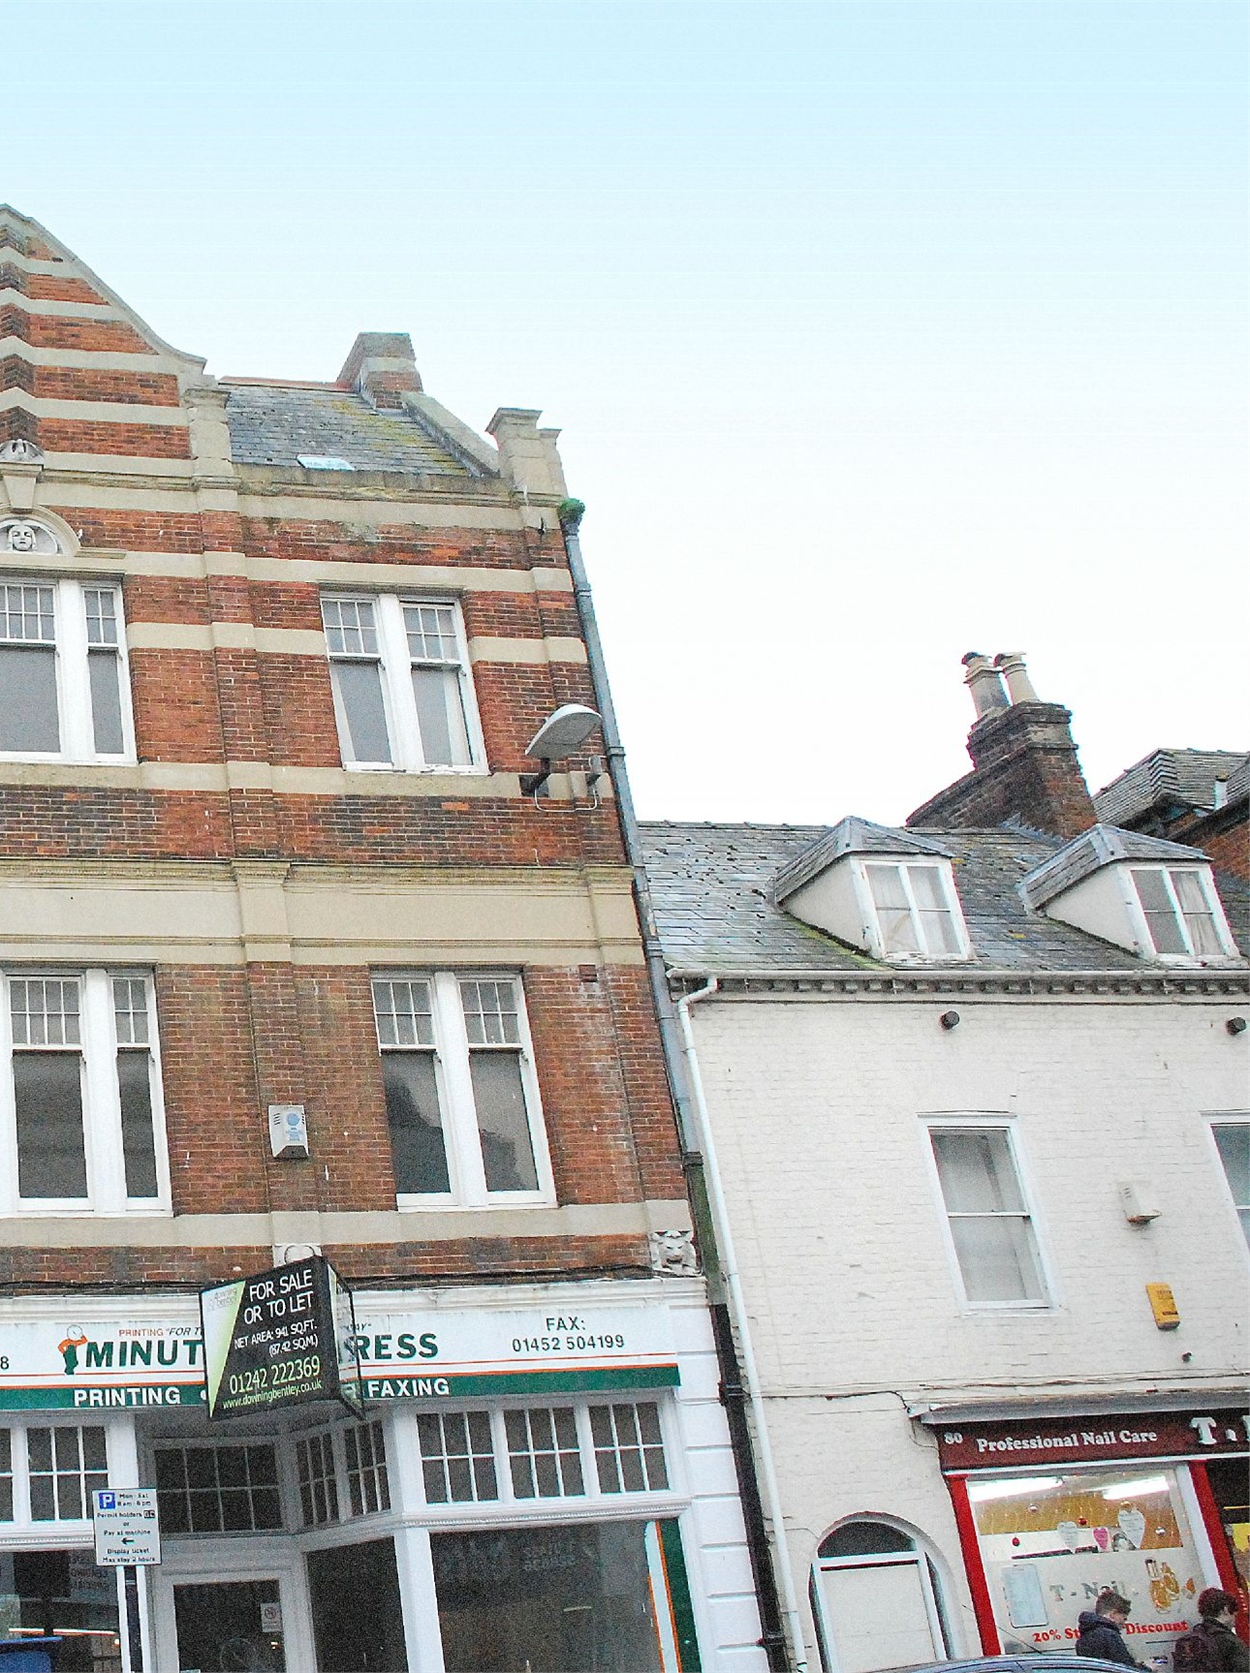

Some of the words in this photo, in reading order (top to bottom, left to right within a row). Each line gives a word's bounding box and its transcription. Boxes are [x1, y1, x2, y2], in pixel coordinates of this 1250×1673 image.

[249, 1281, 276, 1302] FOR
[279, 1269, 313, 1294] SALE
[243, 1305, 263, 1325] OR
[266, 1298, 286, 1318] TO
[289, 1291, 314, 1313] LET
[118, 1327, 164, 1337] PRINTING
[545, 1316, 586, 1331] FAX:
[234, 1335, 250, 1350] NET
[251, 1329, 274, 1346] AREA:
[275, 1326, 289, 1339] 941
[355, 1332, 439, 1360] RESS
[512, 1336, 561, 1352] 01452
[566, 1334, 625, 1350] 504199
[86, 1339, 205, 1368] MINUT
[229, 1368, 268, 1395] 01242
[270, 1355, 320, 1385] 222369
[73, 1387, 181, 1407] PRINTING
[222, 1380, 323, 1409] www.downingbentley.co.uk
[366, 1378, 450, 1397] FAXING
[944, 1431, 964, 1445] 80
[976, 1433, 1079, 1453] Professional
[1080, 1430, 1117, 1446] Nail
[1118, 1429, 1158, 1443] Care
[1032, 1629, 1061, 1643] 20%
[1125, 1620, 1190, 1635] Discount
